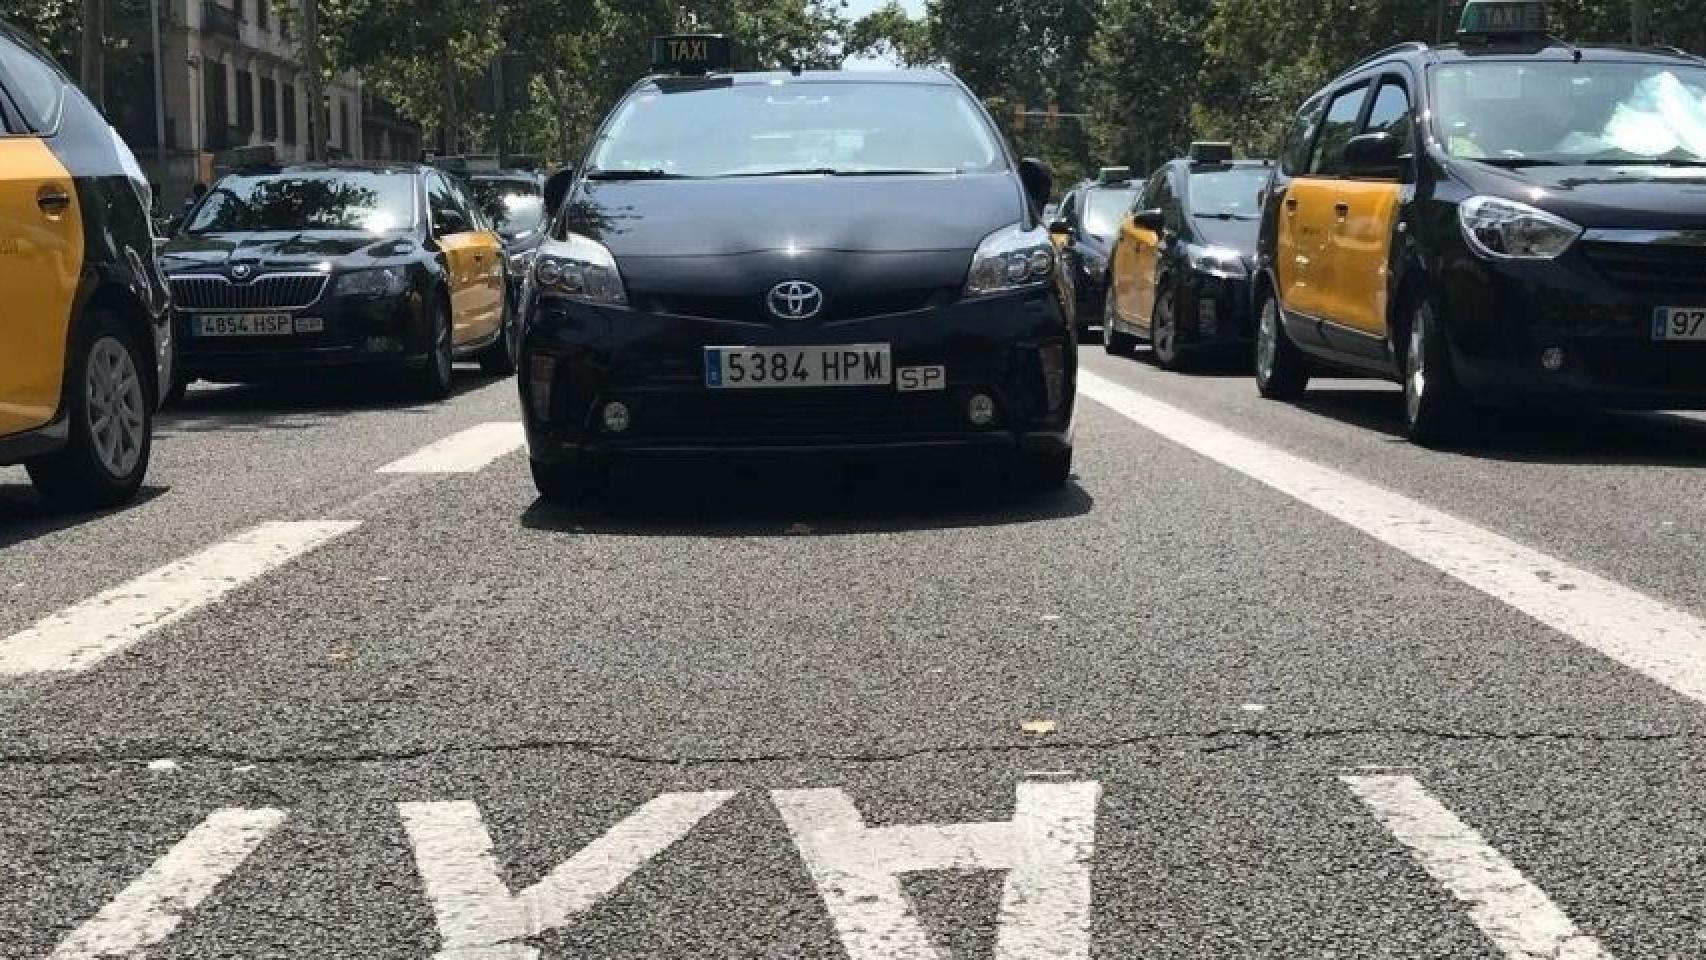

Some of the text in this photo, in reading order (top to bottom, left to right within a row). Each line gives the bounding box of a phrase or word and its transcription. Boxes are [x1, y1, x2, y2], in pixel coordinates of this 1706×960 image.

[1484, 7, 1522, 25] TAXI
[668, 40, 707, 61] TAXI
[205, 315, 289, 333] 4854 HSP
[1672, 311, 1705, 337] 97
[728, 350, 883, 383] 5384 HPM
[901, 368, 941, 389] SP
